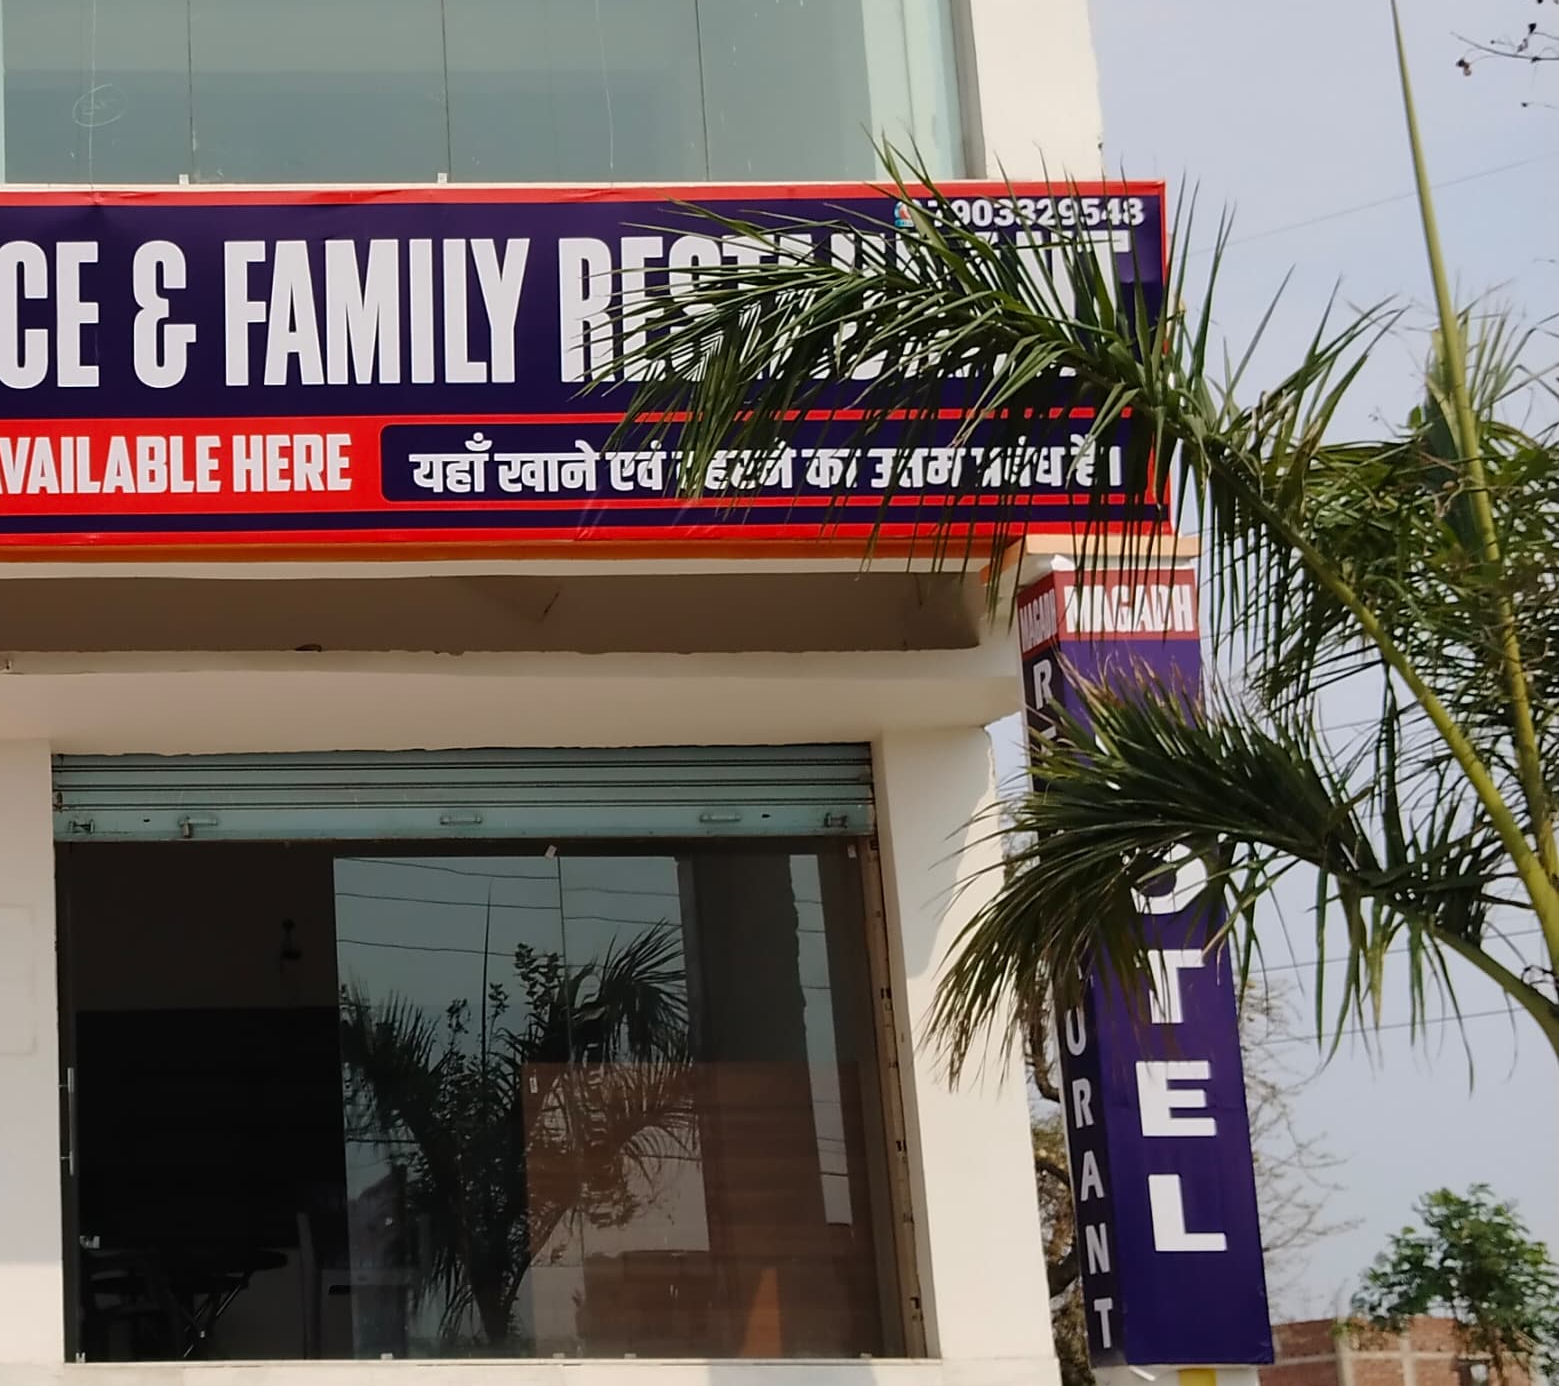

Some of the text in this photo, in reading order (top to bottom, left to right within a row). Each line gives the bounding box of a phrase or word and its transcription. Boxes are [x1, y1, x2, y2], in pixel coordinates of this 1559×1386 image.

[133, 240, 197, 389] &
[224, 238, 530, 386] FAMILY
[232, 433, 352, 492] HERE
[408, 431, 493, 493] यहाँ
[493, 439, 601, 493] खाने
[605, 439, 668, 492] एवं
[1062, 584, 1196, 634] MAGADH
[1098, 733, 1228, 1252] OTEL
